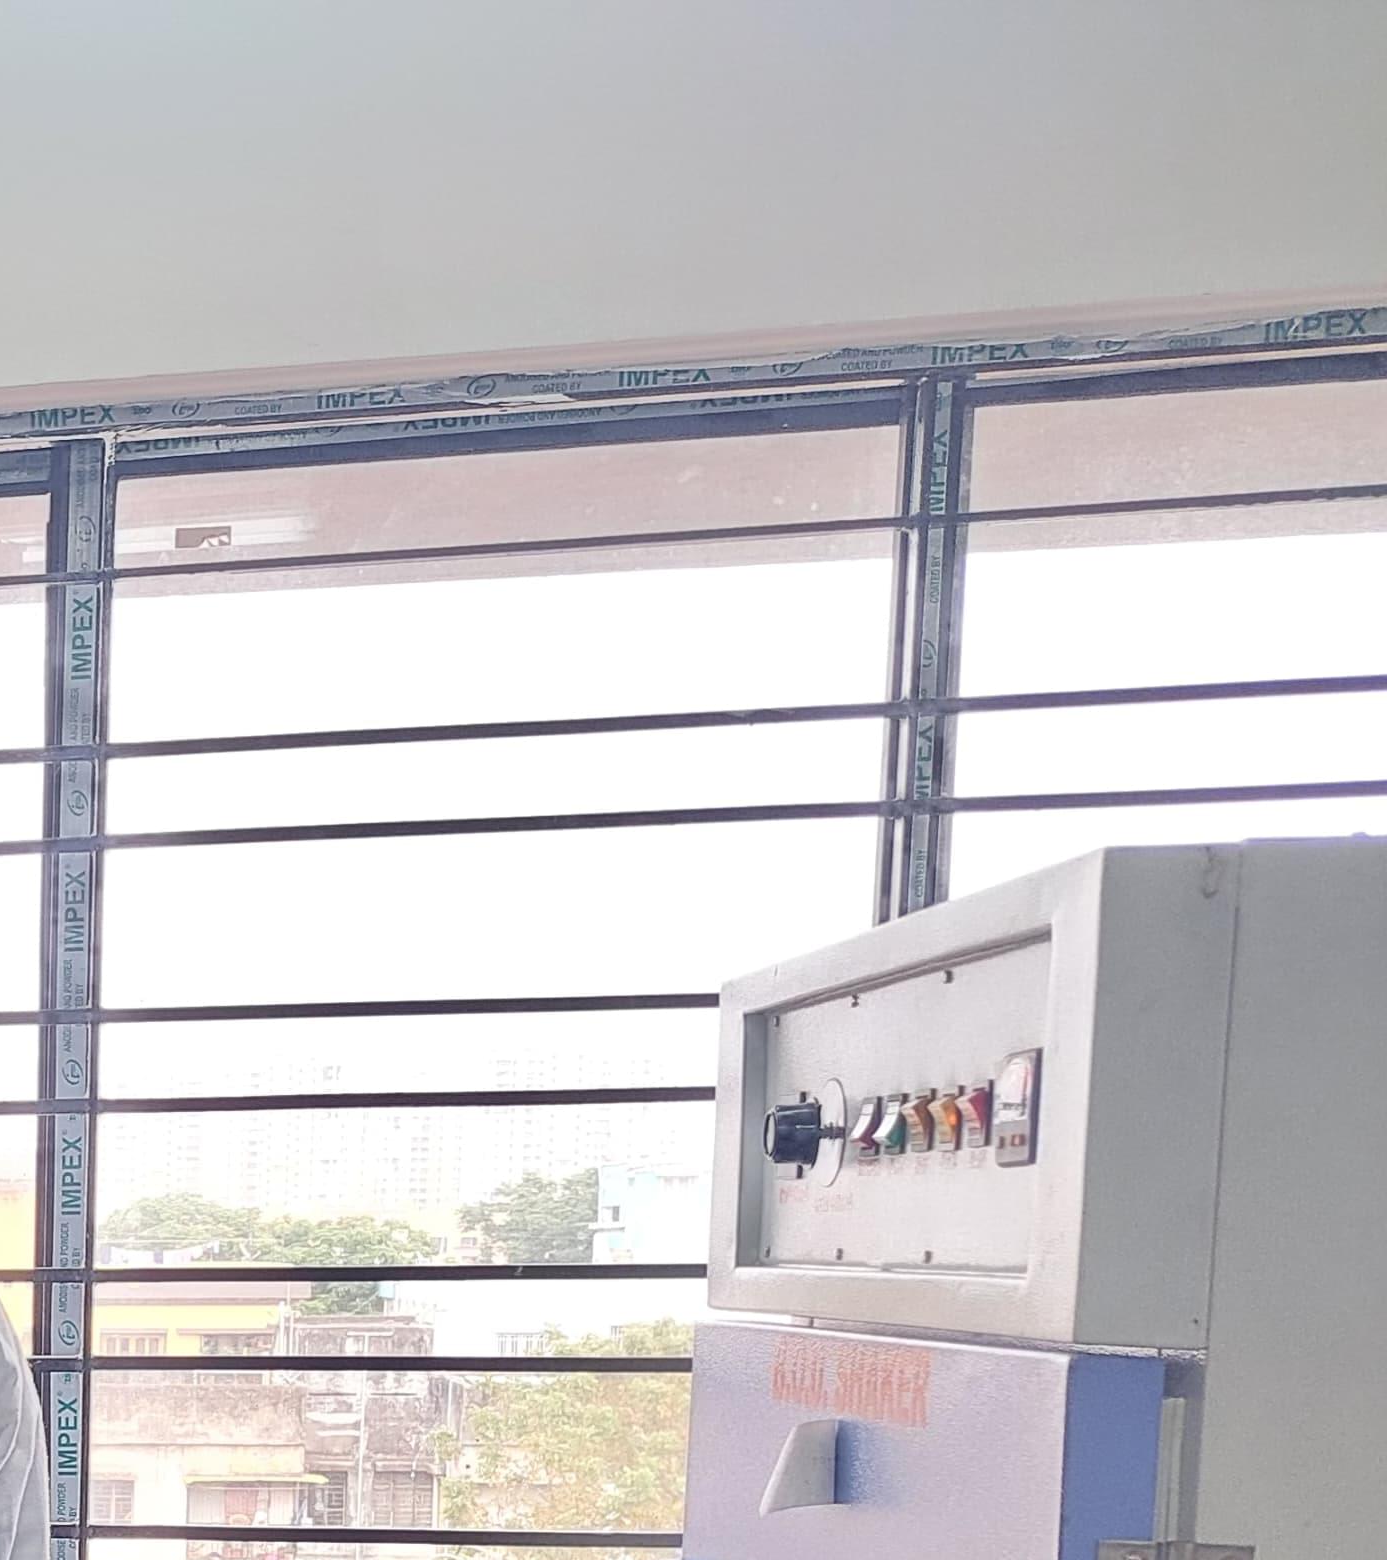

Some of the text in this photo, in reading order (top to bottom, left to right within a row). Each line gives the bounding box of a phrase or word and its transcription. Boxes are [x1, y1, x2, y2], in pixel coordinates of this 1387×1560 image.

[930, 342, 1030, 366] IMPEX
[31, 404, 116, 429] IMPEX
[234, 403, 283, 416] COATED BY
[929, 554, 941, 604] COATED BY
[70, 595, 94, 682] IMPEX
[914, 863, 925, 898] COATED
[63, 871, 86, 954] IMPEX
[60, 1136, 83, 1217] IMPEX
[59, 1222, 69, 1256] POWDER
[71, 1247, 81, 1258] BY
[56, 1396, 79, 1478] IMPEX
[56, 1481, 67, 1517] POWDER
[68, 1507, 77, 1519] BY
